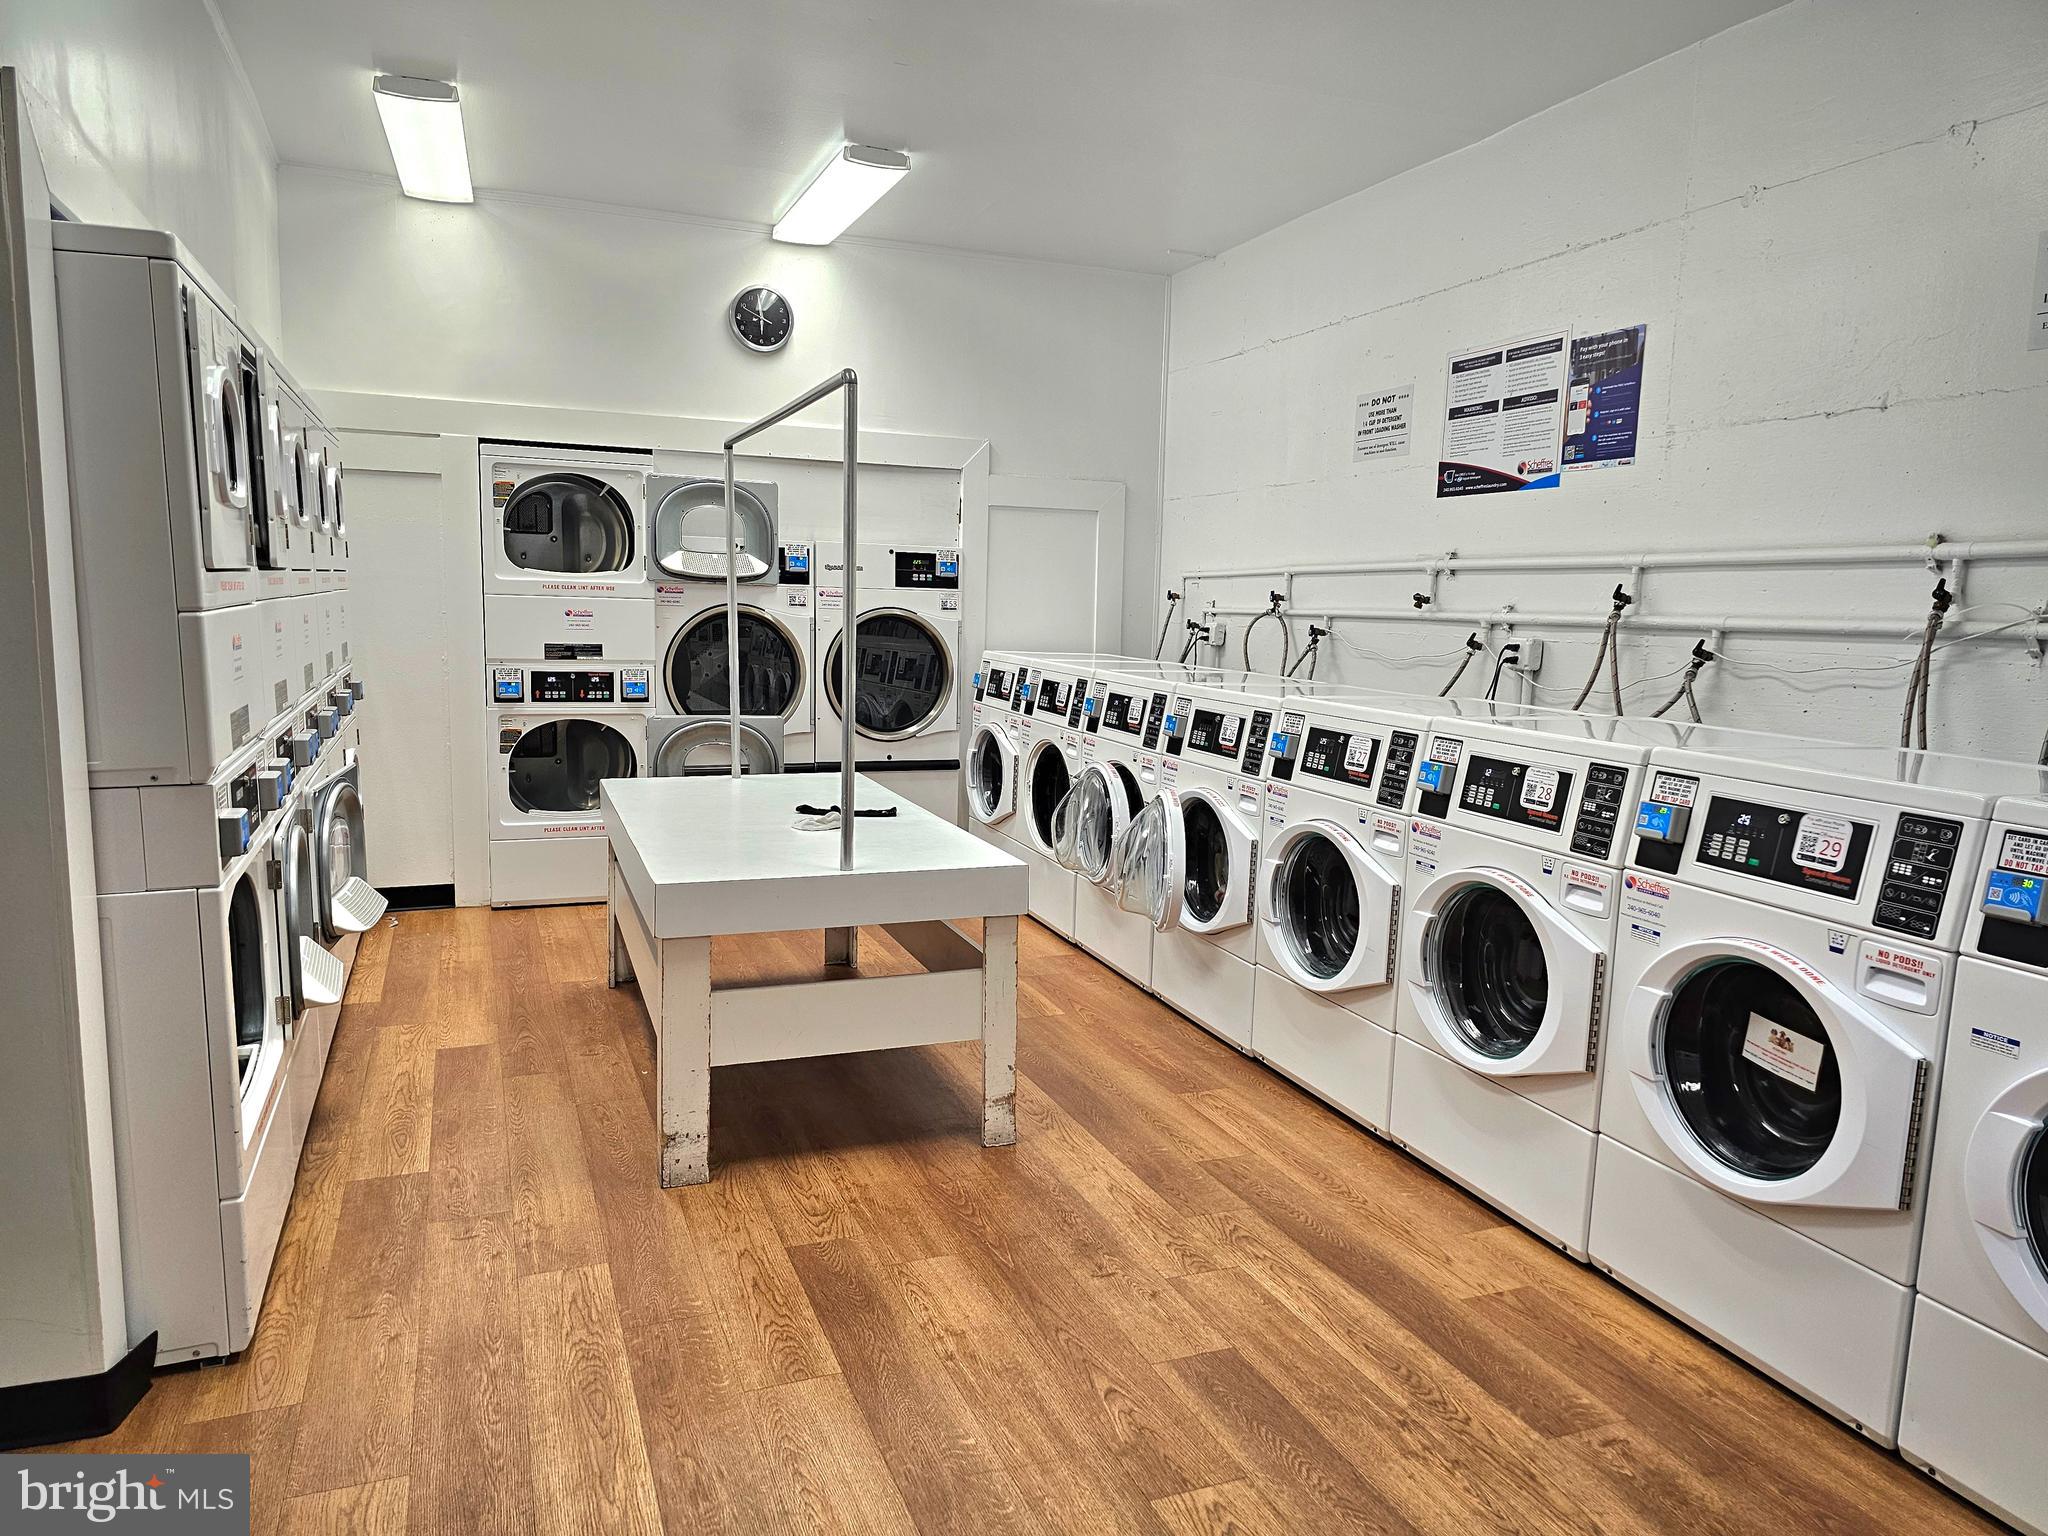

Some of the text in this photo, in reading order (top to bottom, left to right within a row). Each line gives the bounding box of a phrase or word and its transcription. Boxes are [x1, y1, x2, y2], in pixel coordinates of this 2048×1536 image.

[1609, 339, 1622, 347] phone
[1372, 395, 1396, 406] DO NOT
[1375, 425, 1390, 434] LOADING
[1527, 458, 1553, 470] Scheffres
[1228, 729, 1235, 738] 26
[1357, 751, 1367, 762] 27
[1538, 787, 1552, 800] 28
[1818, 839, 1842, 858] 29
[2026, 856, 2045, 864] REMOVE
[2031, 863, 2044, 871] TAP
[1638, 878, 1670, 894] Scheffres
[2022, 879, 2034, 888] 30
[1627, 904, 1660, 918] 240-965-6040
[1878, 950, 1924, 969] NO PODS!!
[1771, 949, 1799, 966] WHEN
[1798, 967, 1826, 986] DONE
[1892, 962, 1921, 974] DETERGENT
[1983, 1032, 2008, 1044] NOTICE
